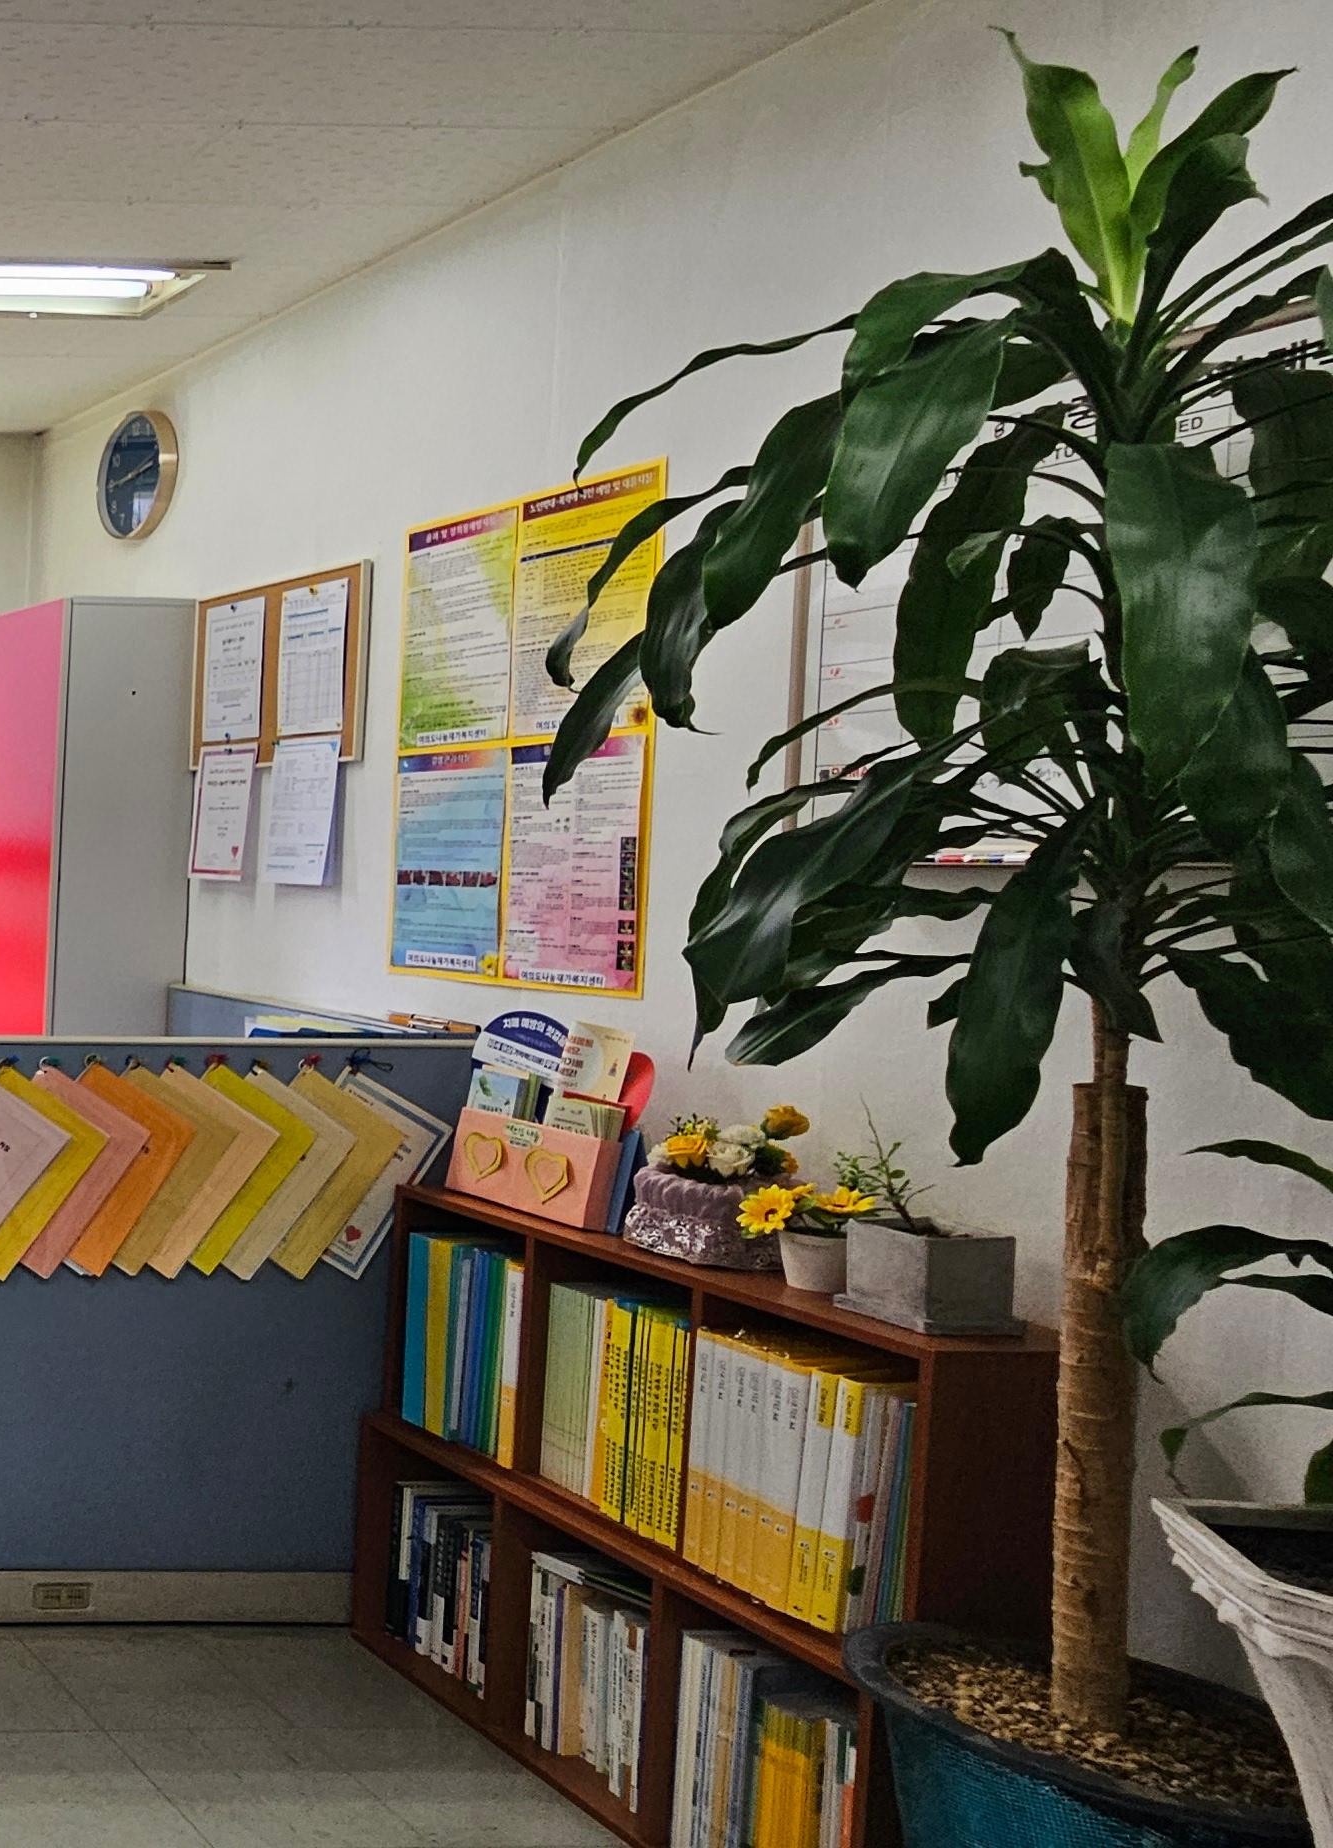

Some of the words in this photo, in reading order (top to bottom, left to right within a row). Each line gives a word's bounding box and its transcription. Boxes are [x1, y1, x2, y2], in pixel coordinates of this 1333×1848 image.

[407, 954, 475, 968] 여의도나눔재가복지센터
[521, 970, 603, 986] 여의도나눔재가복지센터
[503, 1018, 520, 1029] 치매
[521, 1018, 545, 1032] 예방의
